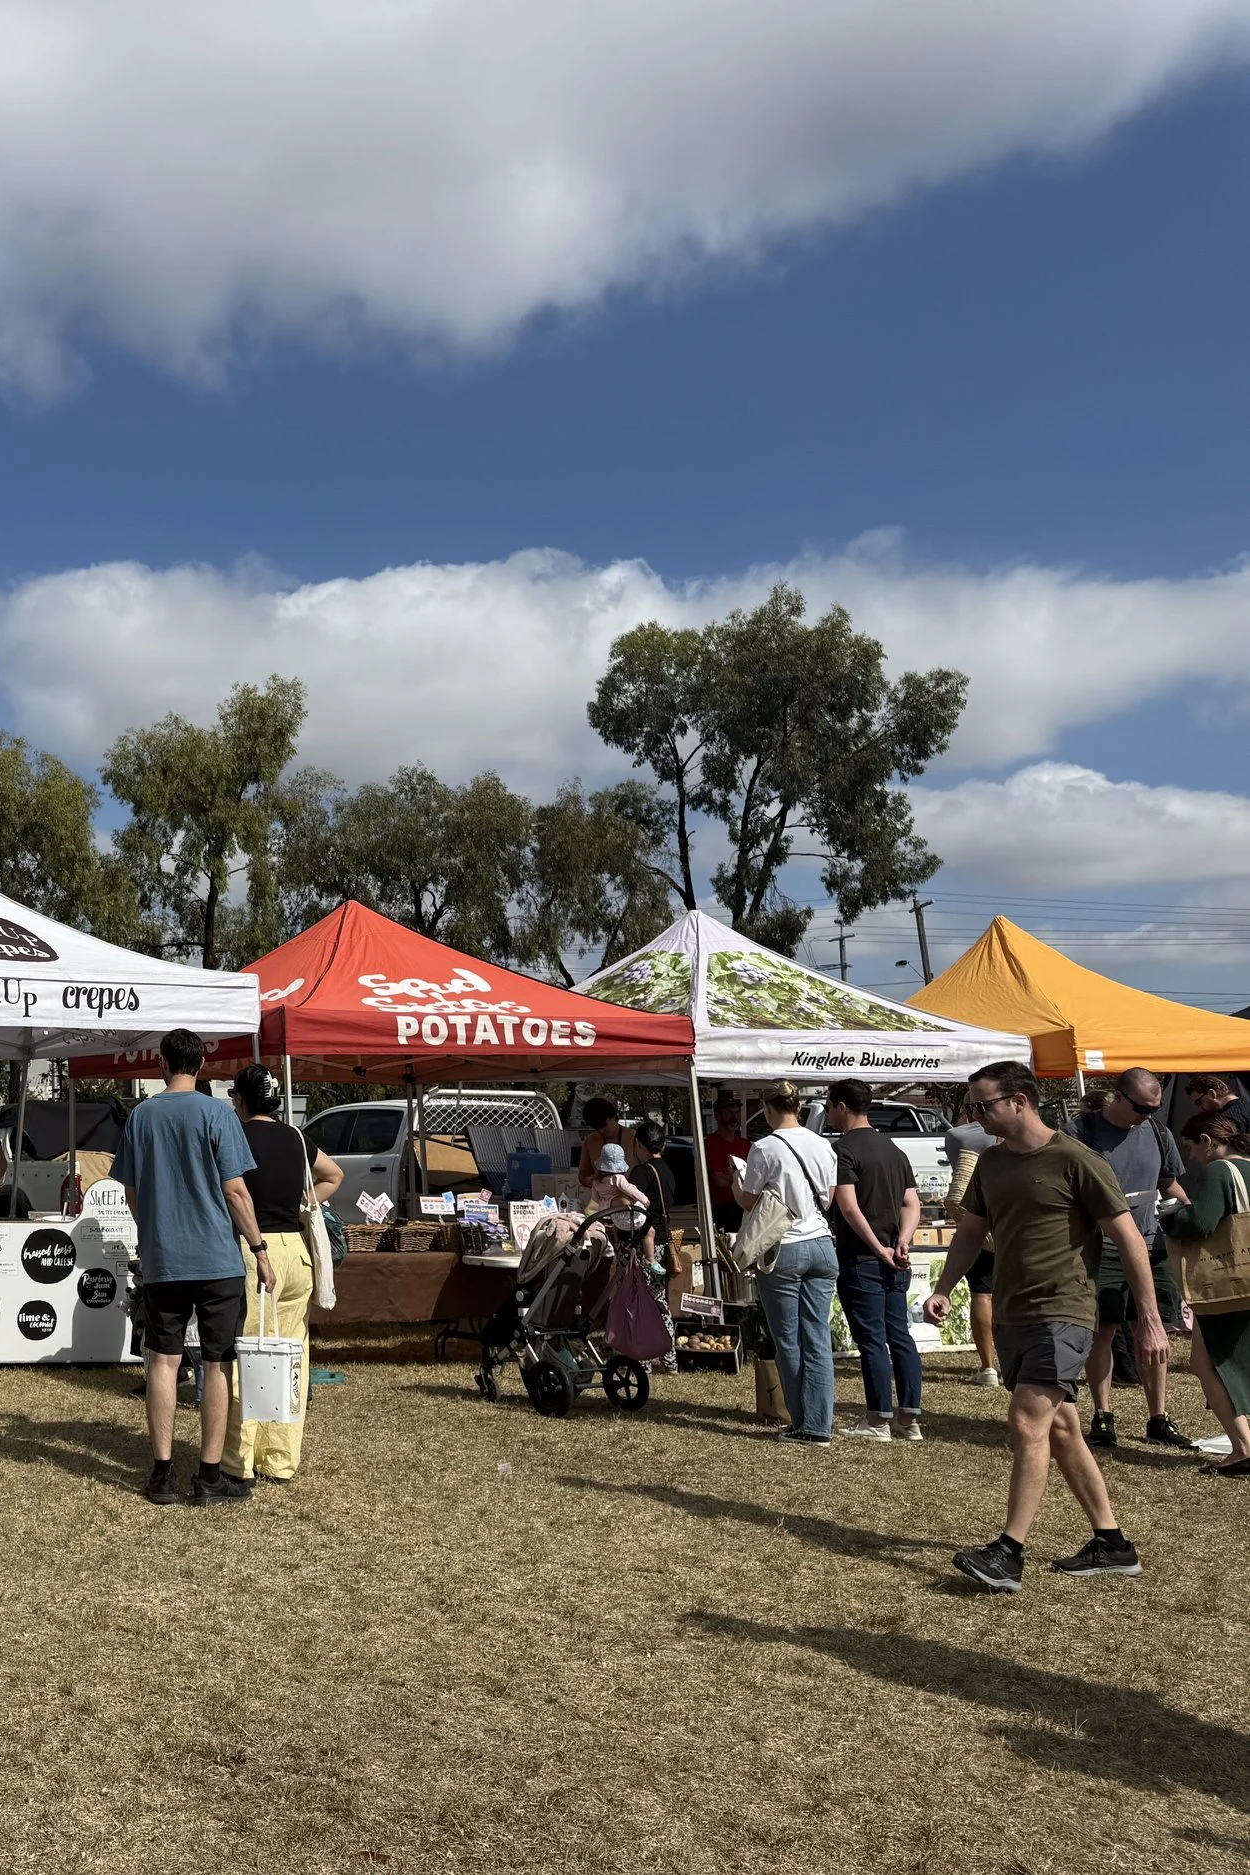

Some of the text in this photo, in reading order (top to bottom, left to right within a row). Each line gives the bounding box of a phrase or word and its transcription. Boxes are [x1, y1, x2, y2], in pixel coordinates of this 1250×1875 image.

[358, 968, 492, 997] Spud
[62, 985, 140, 1018] crepes
[396, 1014, 596, 1047] POTATOES
[791, 1051, 940, 1070] Kinglake Blueberries
[90, 1189, 119, 1207] SWEET
[41, 1257, 74, 1266] AND CHEESE
[19, 1312, 50, 1322] lime &
